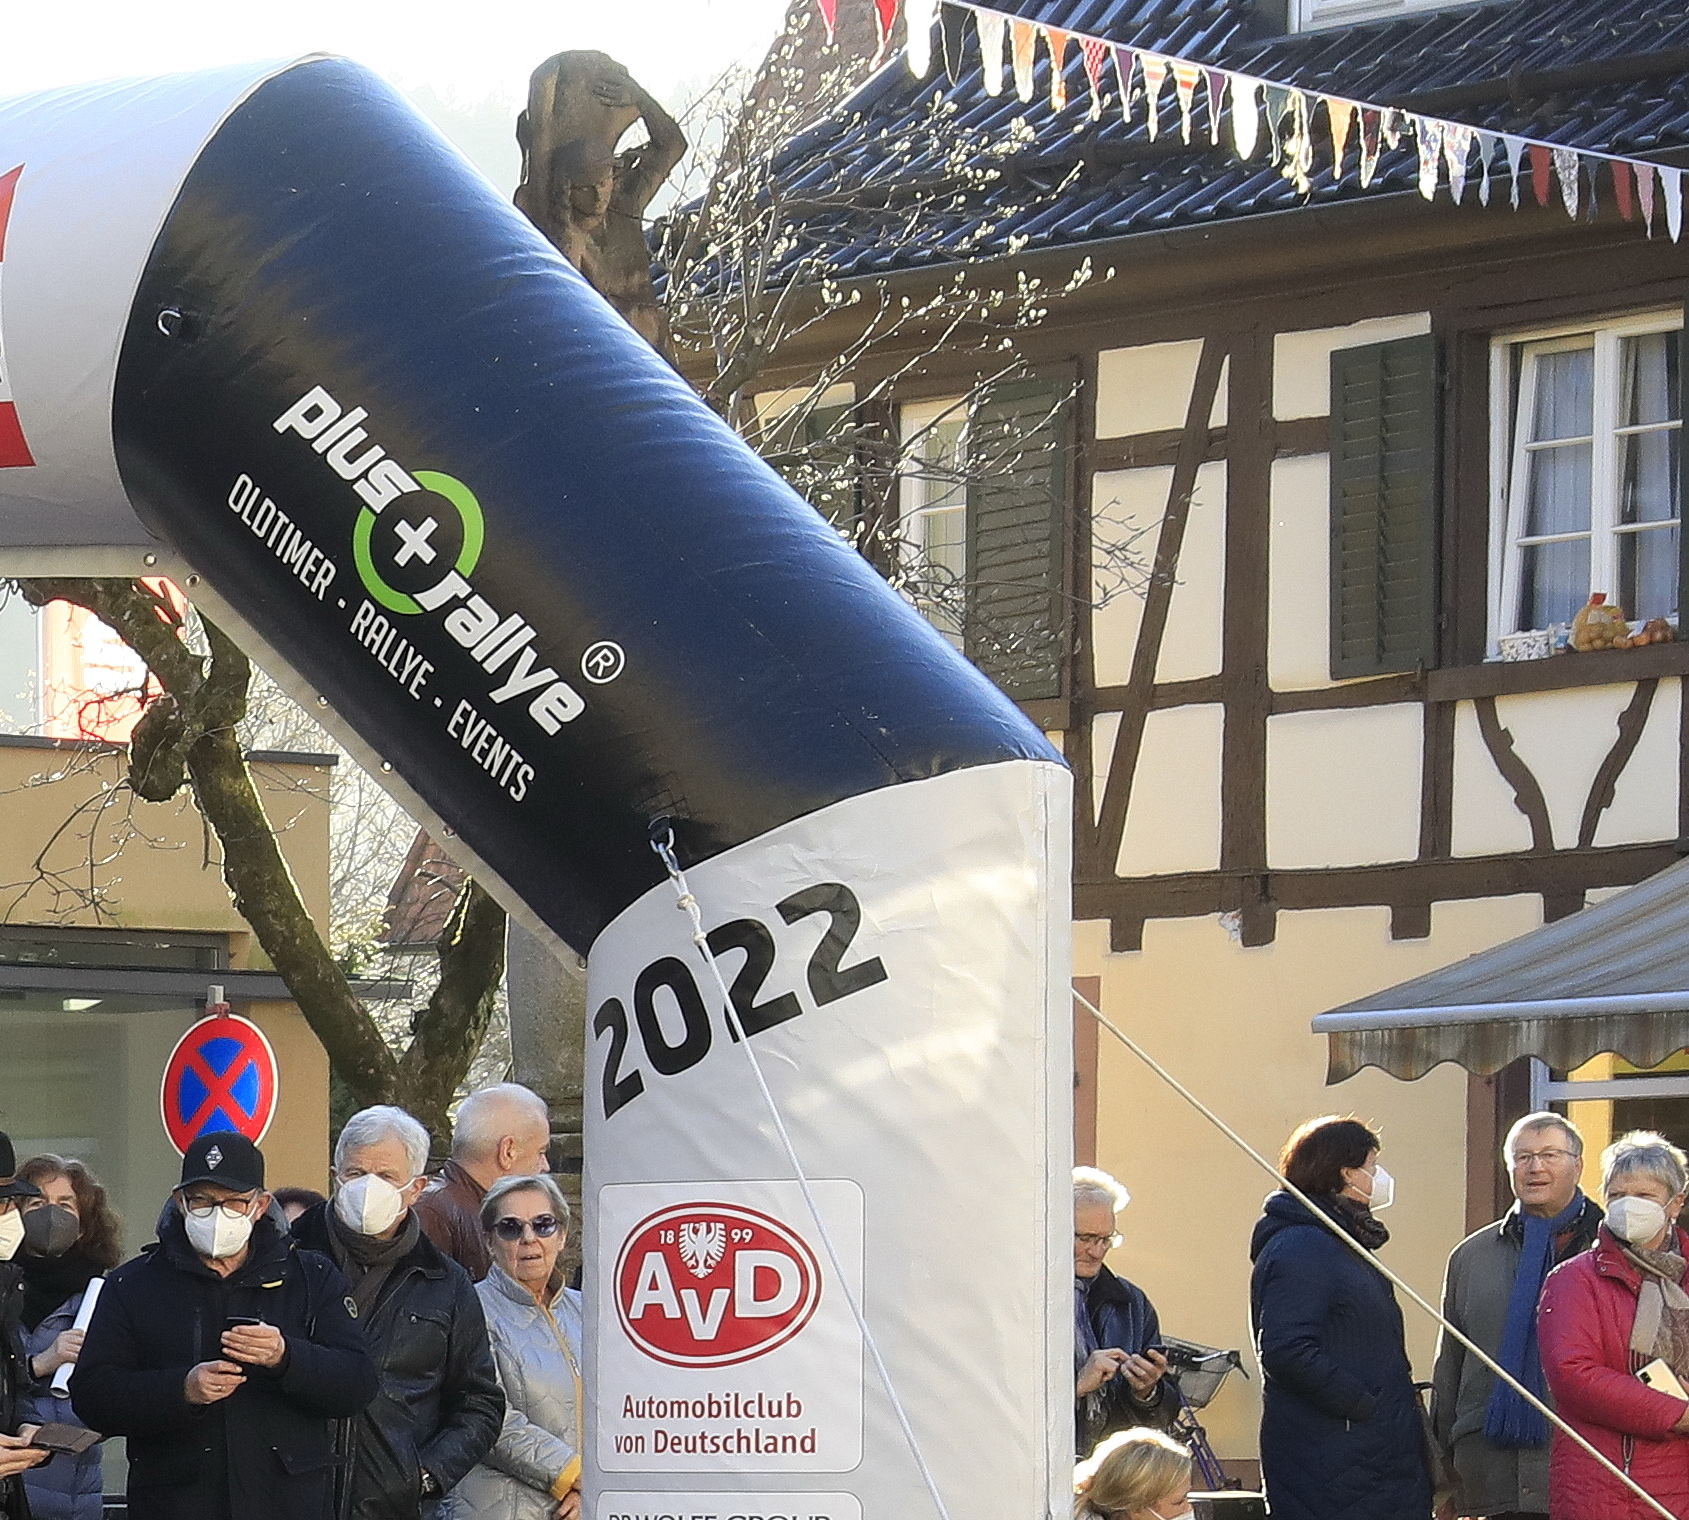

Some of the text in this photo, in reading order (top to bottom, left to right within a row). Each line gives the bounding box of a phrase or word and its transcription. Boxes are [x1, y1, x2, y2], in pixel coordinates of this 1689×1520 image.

[228, 473, 534, 802] OLDTIMER RALLYE EVENTS
[593, 881, 889, 1121] 2022
[658, 1228, 754, 1245] 18 99
[621, 1392, 804, 1420] Automobilclub
[614, 1428, 818, 1456] von Deutschland
